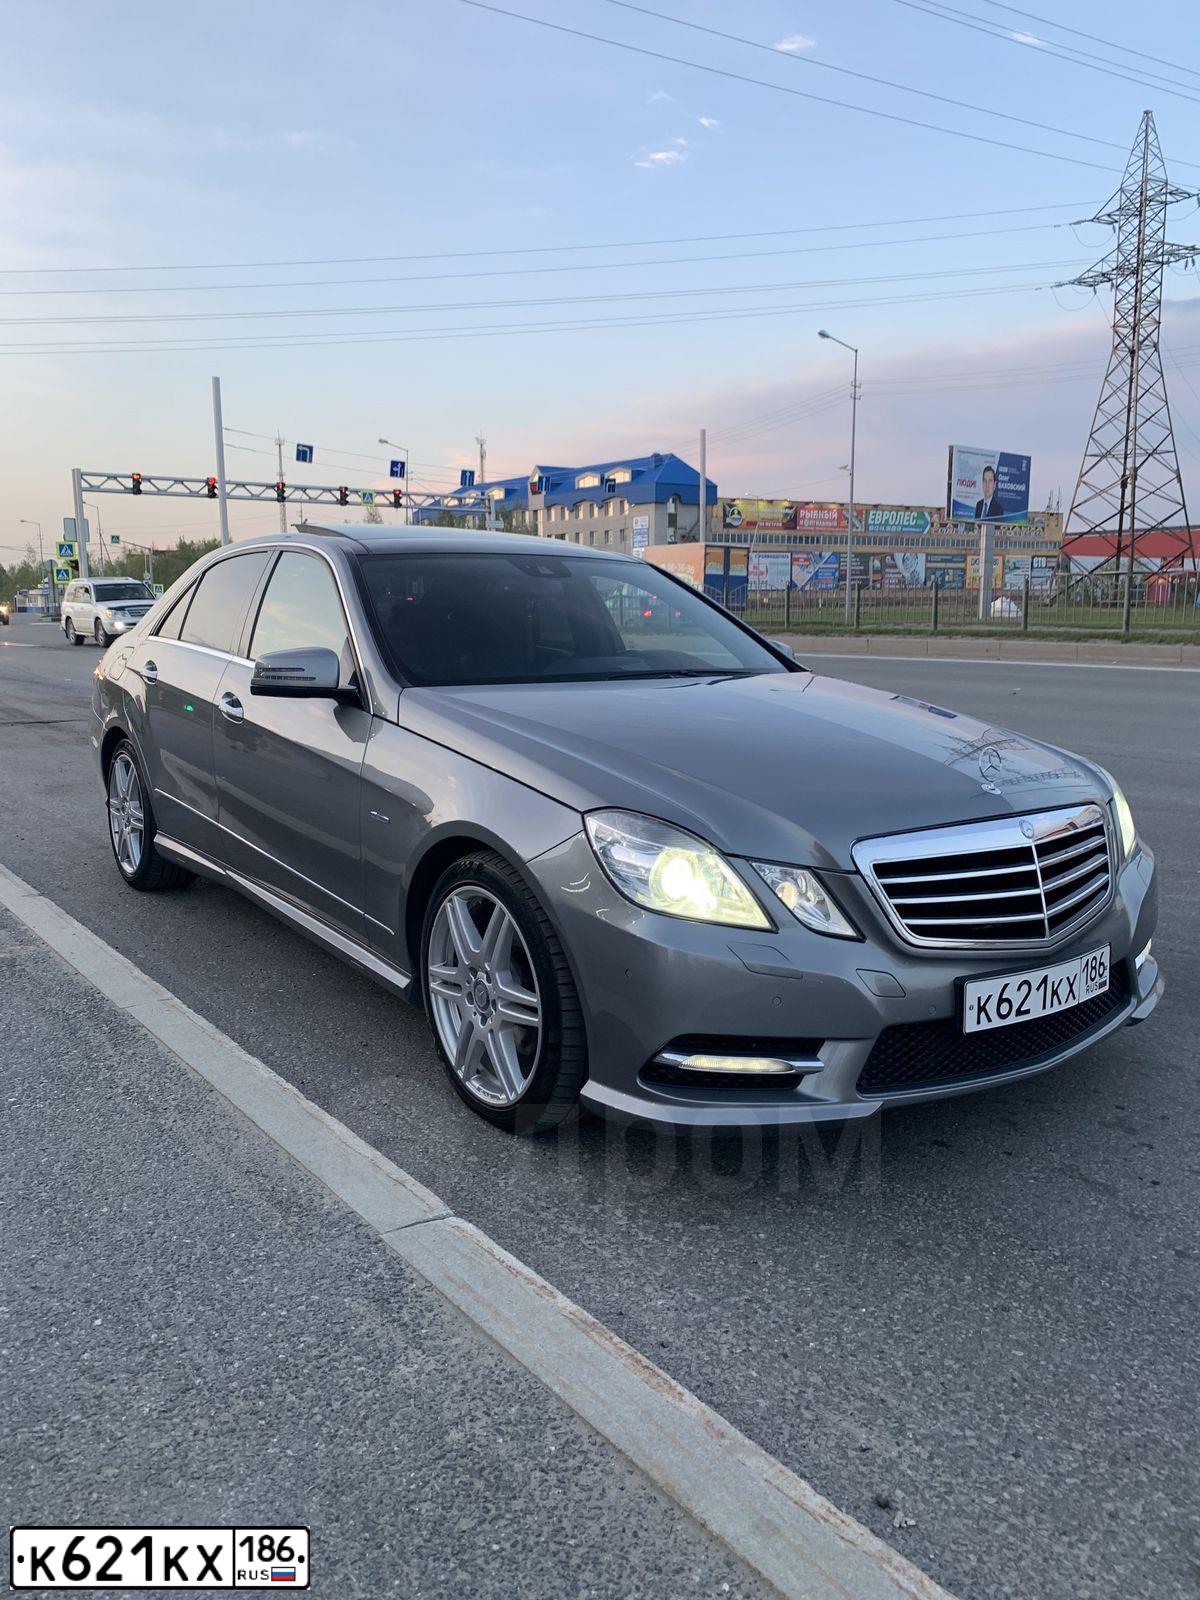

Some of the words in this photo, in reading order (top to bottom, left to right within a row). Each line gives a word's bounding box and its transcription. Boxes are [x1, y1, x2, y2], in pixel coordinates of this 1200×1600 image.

[868, 510, 917, 526] ЕВРОЛЕС
[1034, 556, 1047, 568] СТО
[1082, 952, 1106, 982] 186
[1085, 983, 1100, 995] RUS
[976, 972, 1078, 1025] К621КХ
